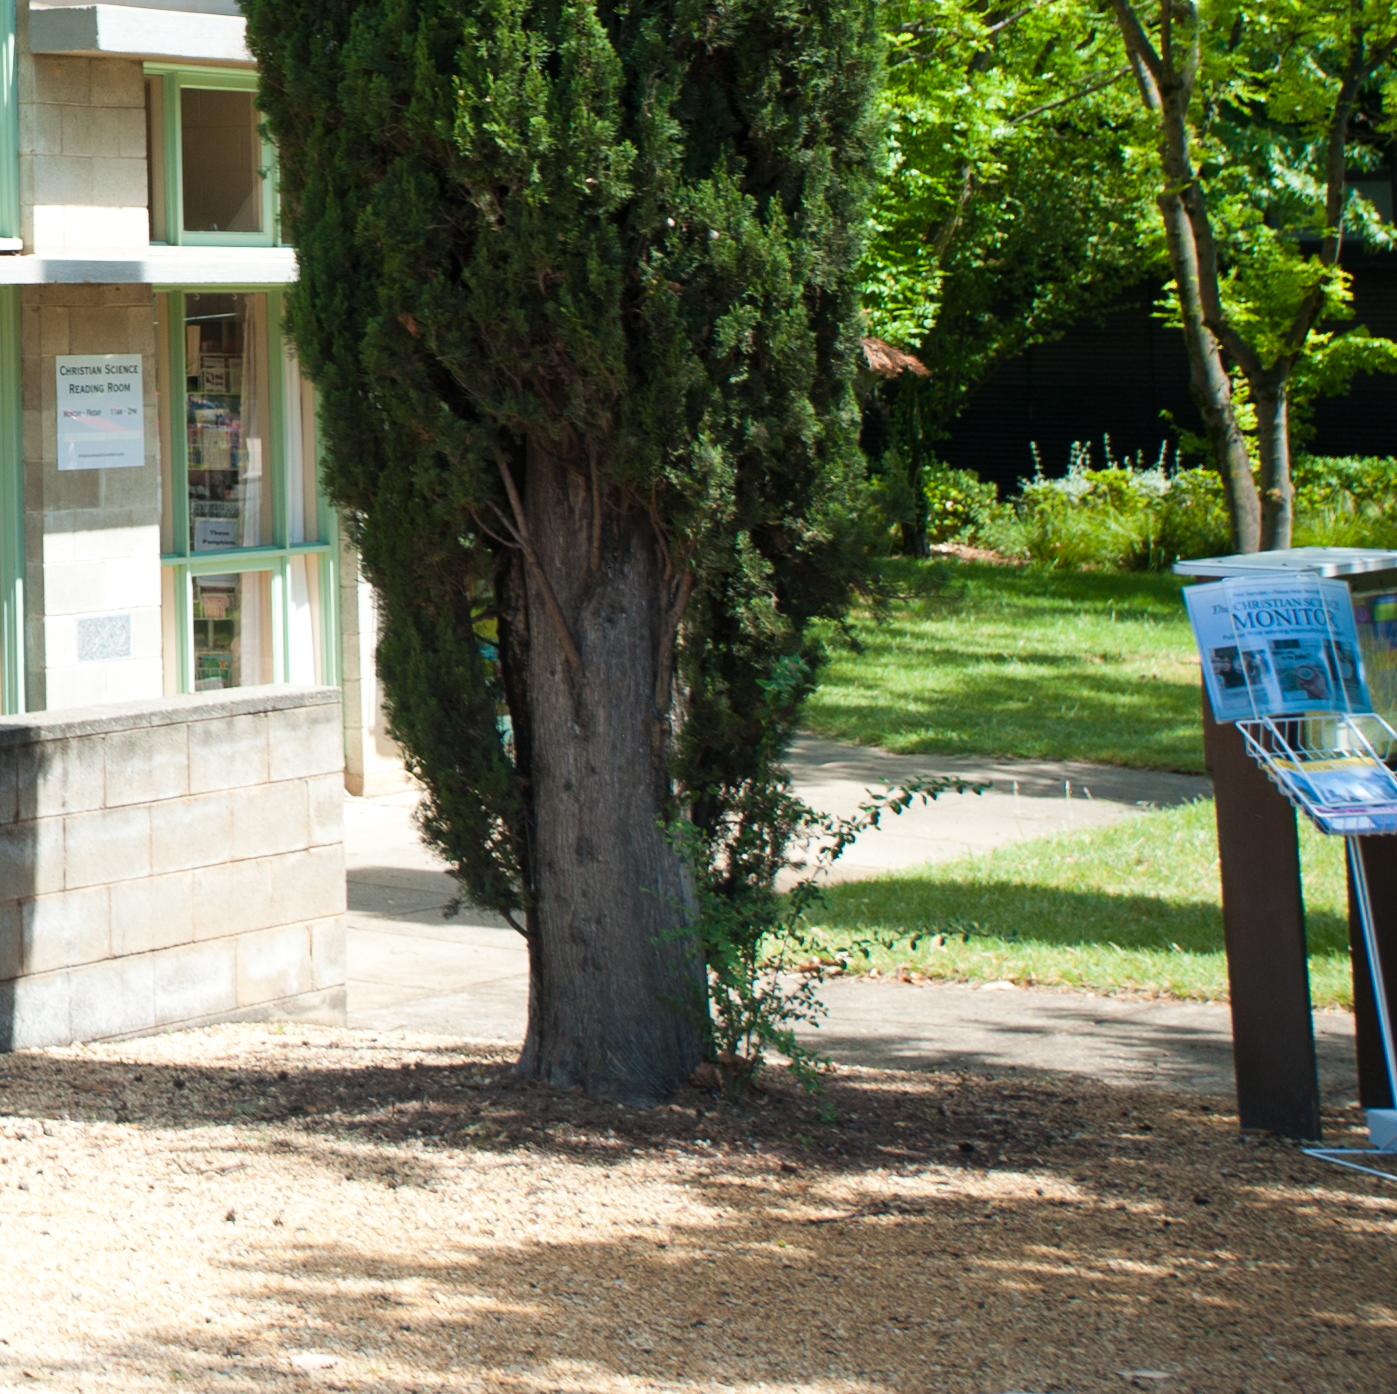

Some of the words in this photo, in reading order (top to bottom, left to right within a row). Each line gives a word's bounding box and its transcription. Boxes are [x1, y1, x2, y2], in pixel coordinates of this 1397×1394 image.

[59, 365, 102, 376] CHRISTIAN
[105, 364, 138, 374] SCIENCE
[69, 384, 104, 394] READING
[107, 382, 131, 393] ROOM
[1232, 597, 1301, 611] CHRISTIAN
[1232, 608, 1339, 631] MONITOR
